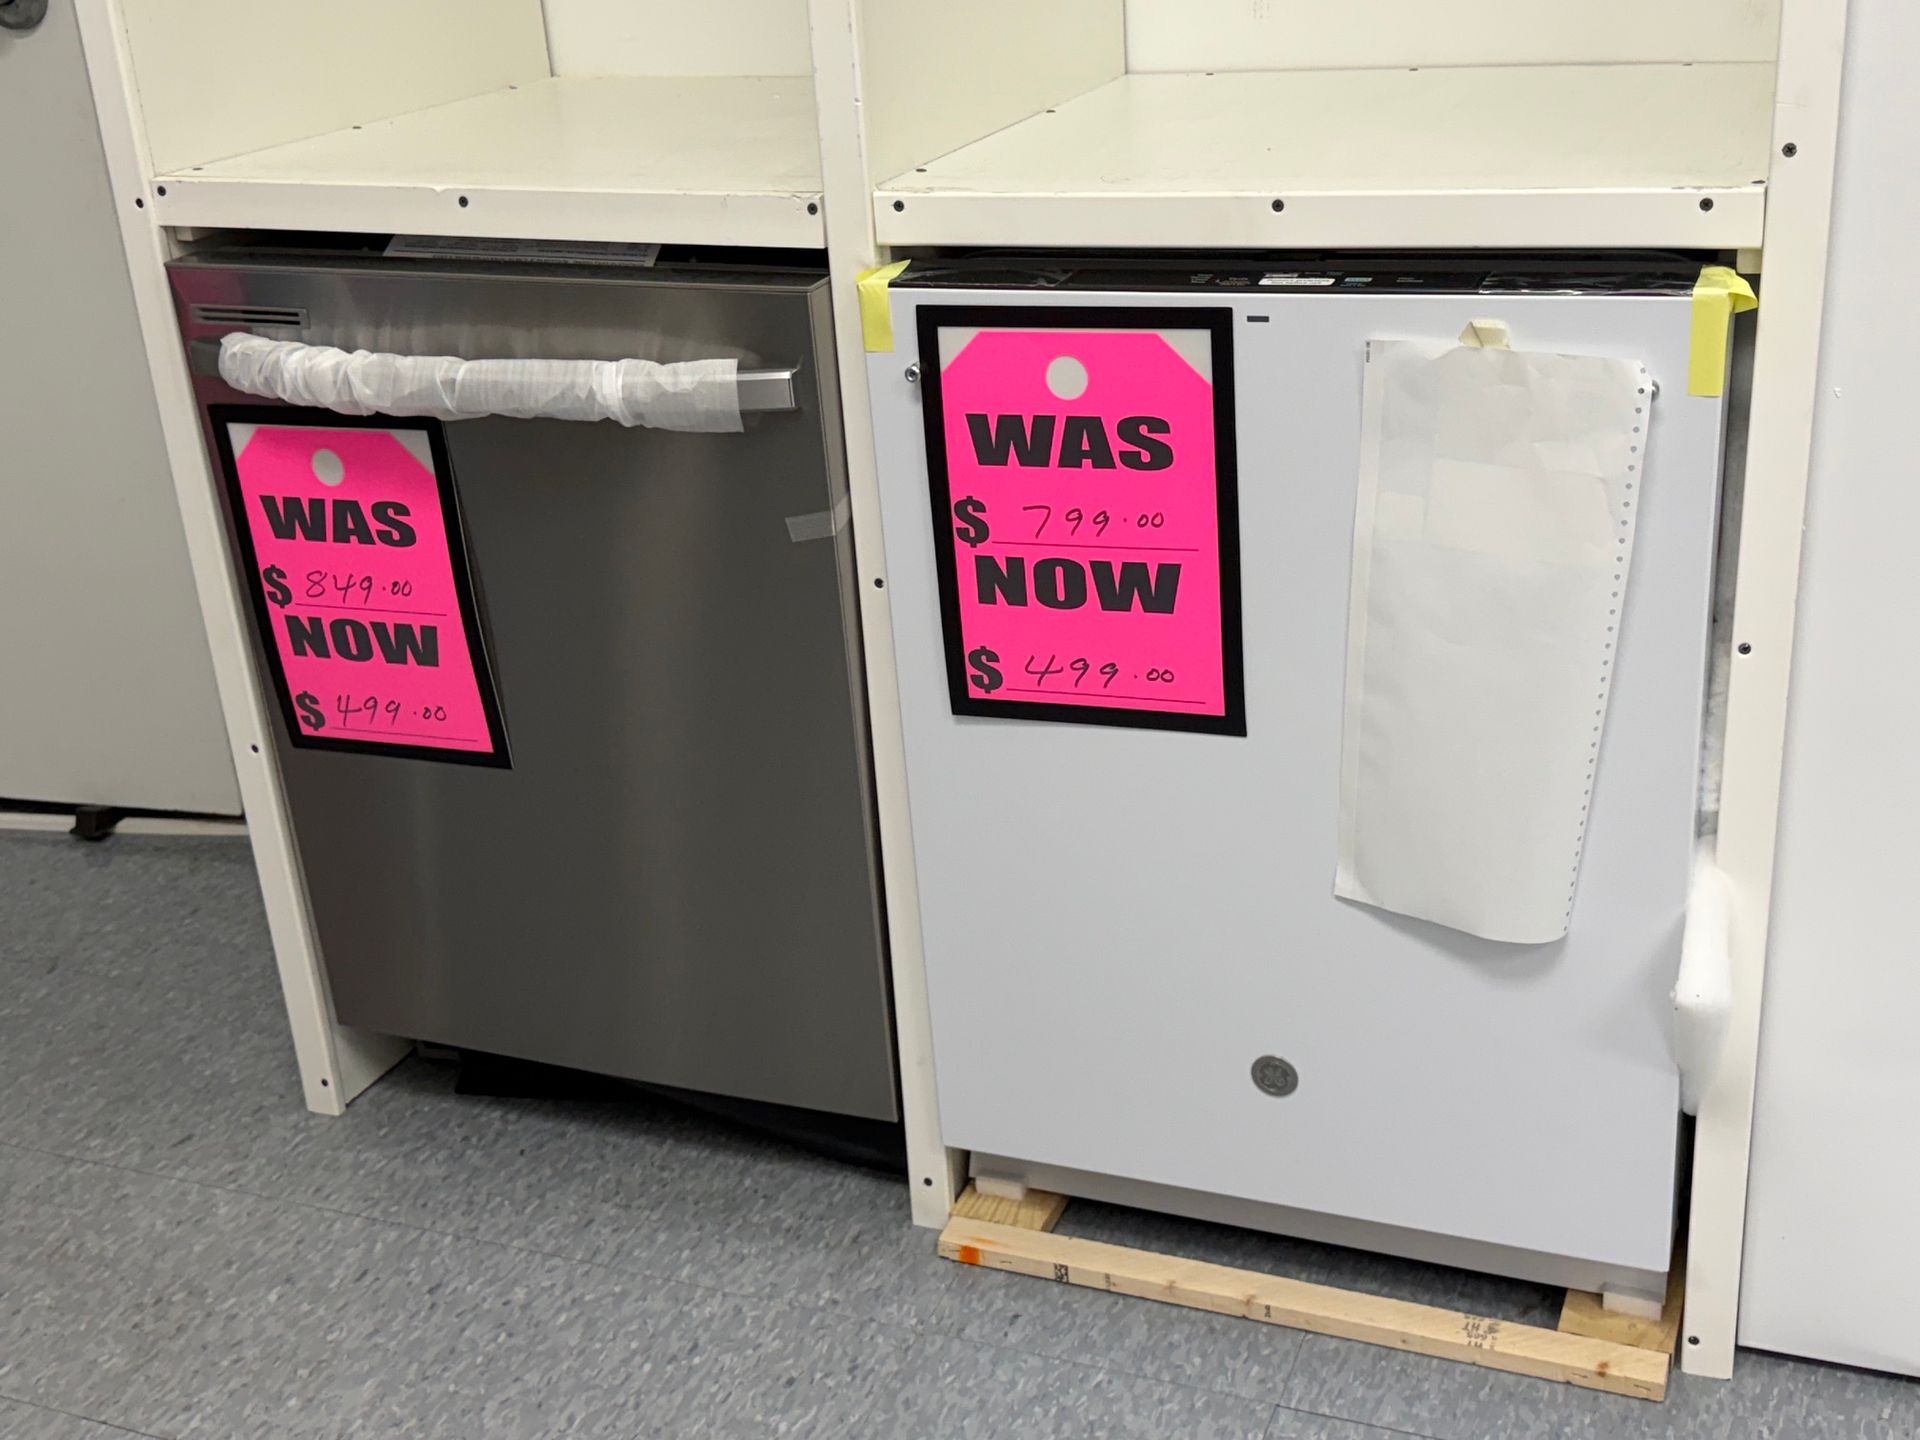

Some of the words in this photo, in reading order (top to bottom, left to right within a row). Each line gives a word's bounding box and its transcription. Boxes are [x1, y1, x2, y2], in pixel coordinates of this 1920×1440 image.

[965, 413, 1174, 471] WAS
[259, 495, 417, 548] WAS
[953, 495, 990, 548] $
[1022, 505, 1165, 539] 799.00
[262, 564, 292, 608] $
[306, 571, 412, 605] 849.00
[974, 555, 1182, 615] NOW
[285, 614, 439, 668] NOW
[968, 645, 1004, 694] $
[1024, 654, 1175, 688] 499.00
[295, 691, 325, 731] $
[336, 694, 448, 728] 499.00
